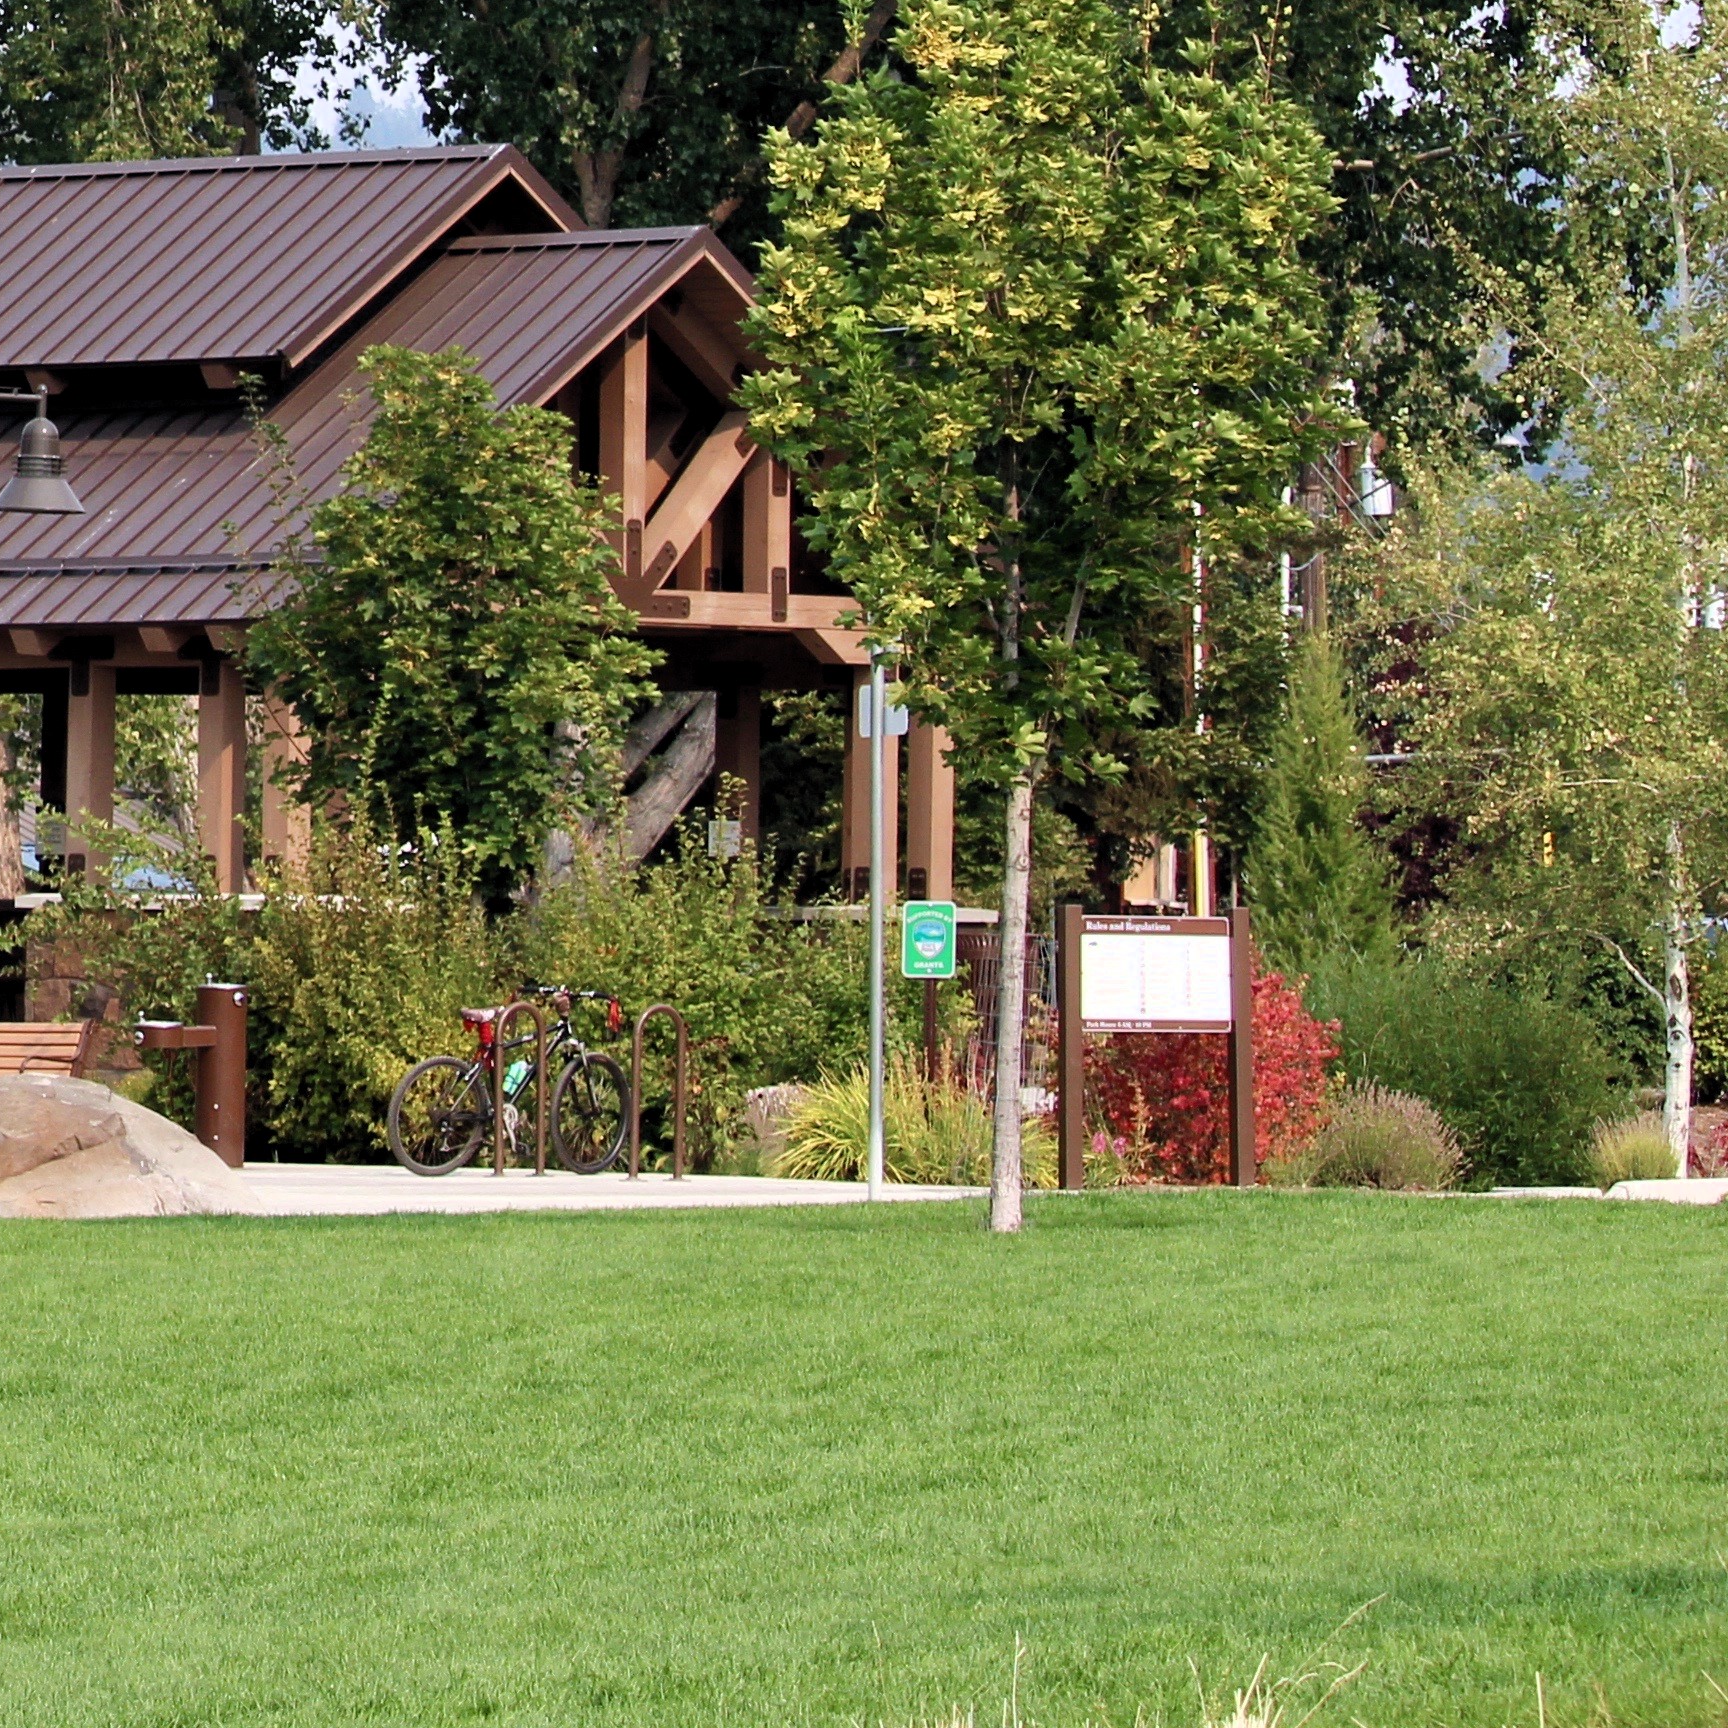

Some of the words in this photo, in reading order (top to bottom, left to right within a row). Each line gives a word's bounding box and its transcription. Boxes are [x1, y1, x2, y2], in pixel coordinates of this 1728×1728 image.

[1085, 920, 1108, 931] Rules
[1109, 921, 1124, 931] and
[1125, 920, 1171, 933] Regulations
[913, 961, 944, 969] GRANTS
